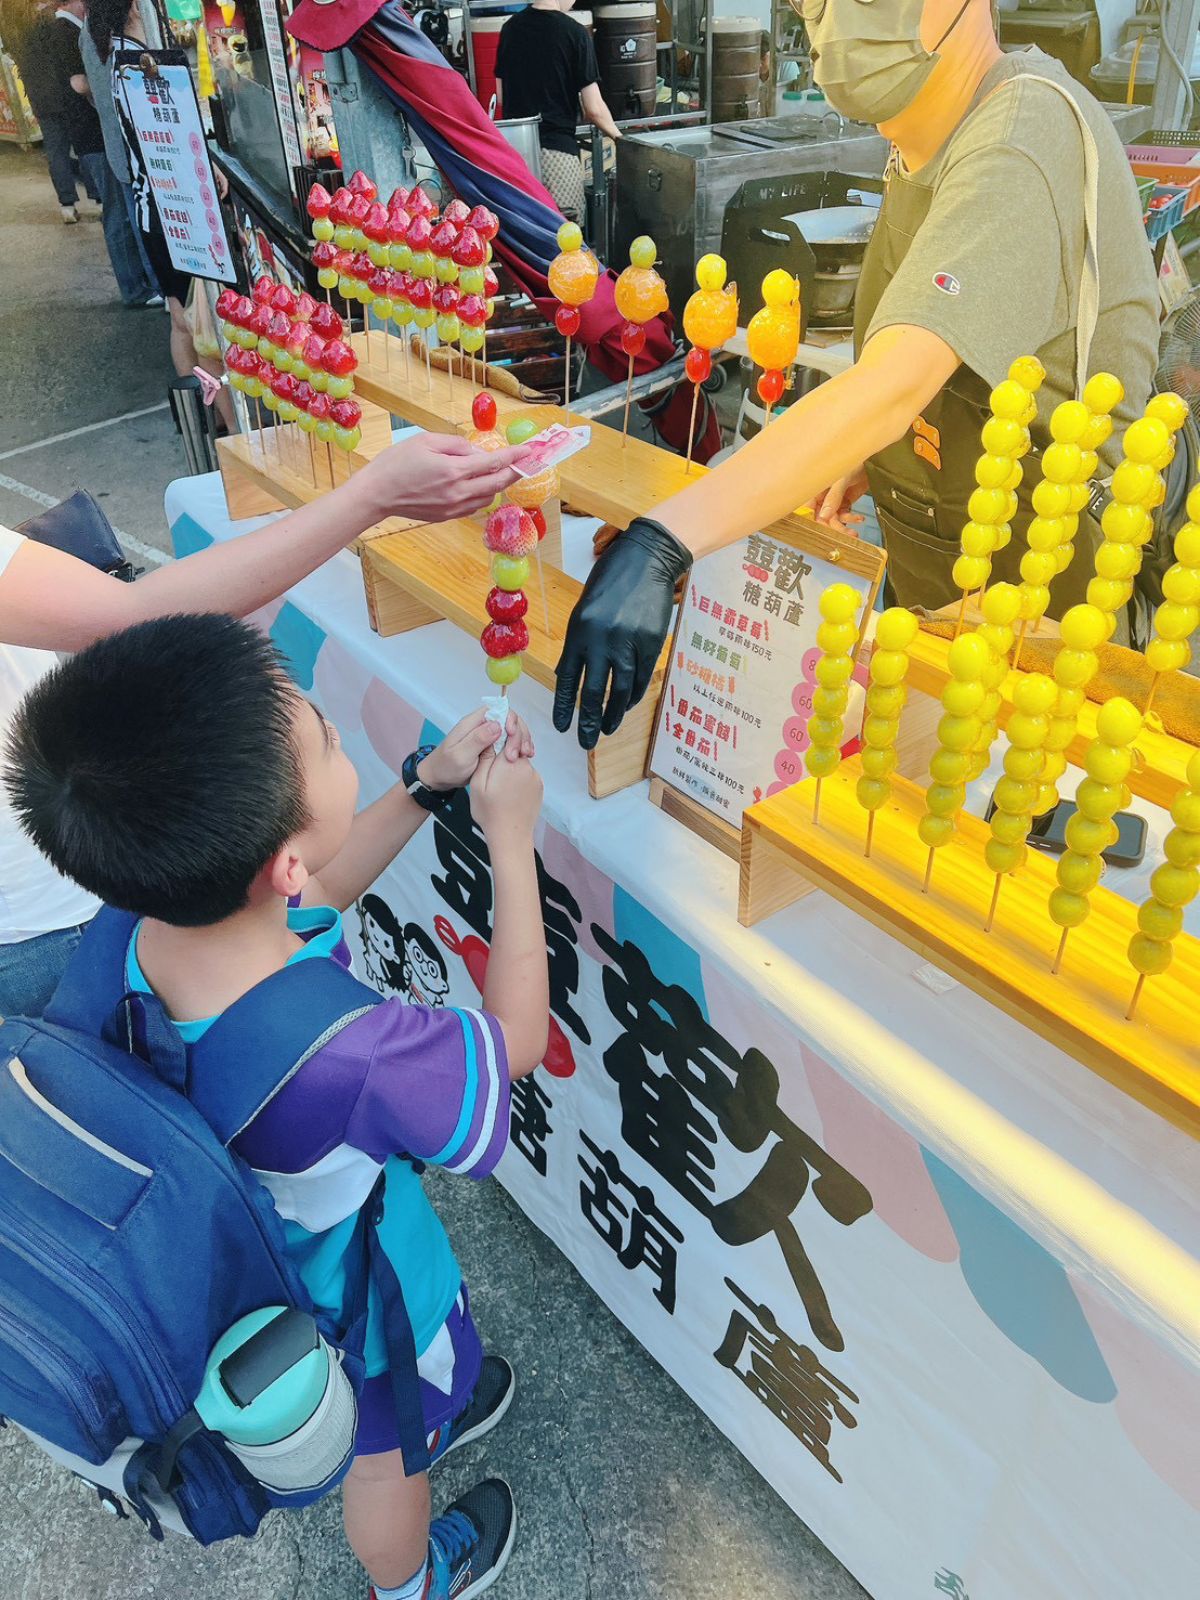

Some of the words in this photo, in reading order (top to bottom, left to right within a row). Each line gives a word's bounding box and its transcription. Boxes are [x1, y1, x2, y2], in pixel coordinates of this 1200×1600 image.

[743, 581, 805, 626] 糖葫蘆
[799, 696, 812, 710] 60
[672, 723, 711, 757] 全番茄
[790, 728, 804, 742] 60
[781, 760, 795, 775] 40
